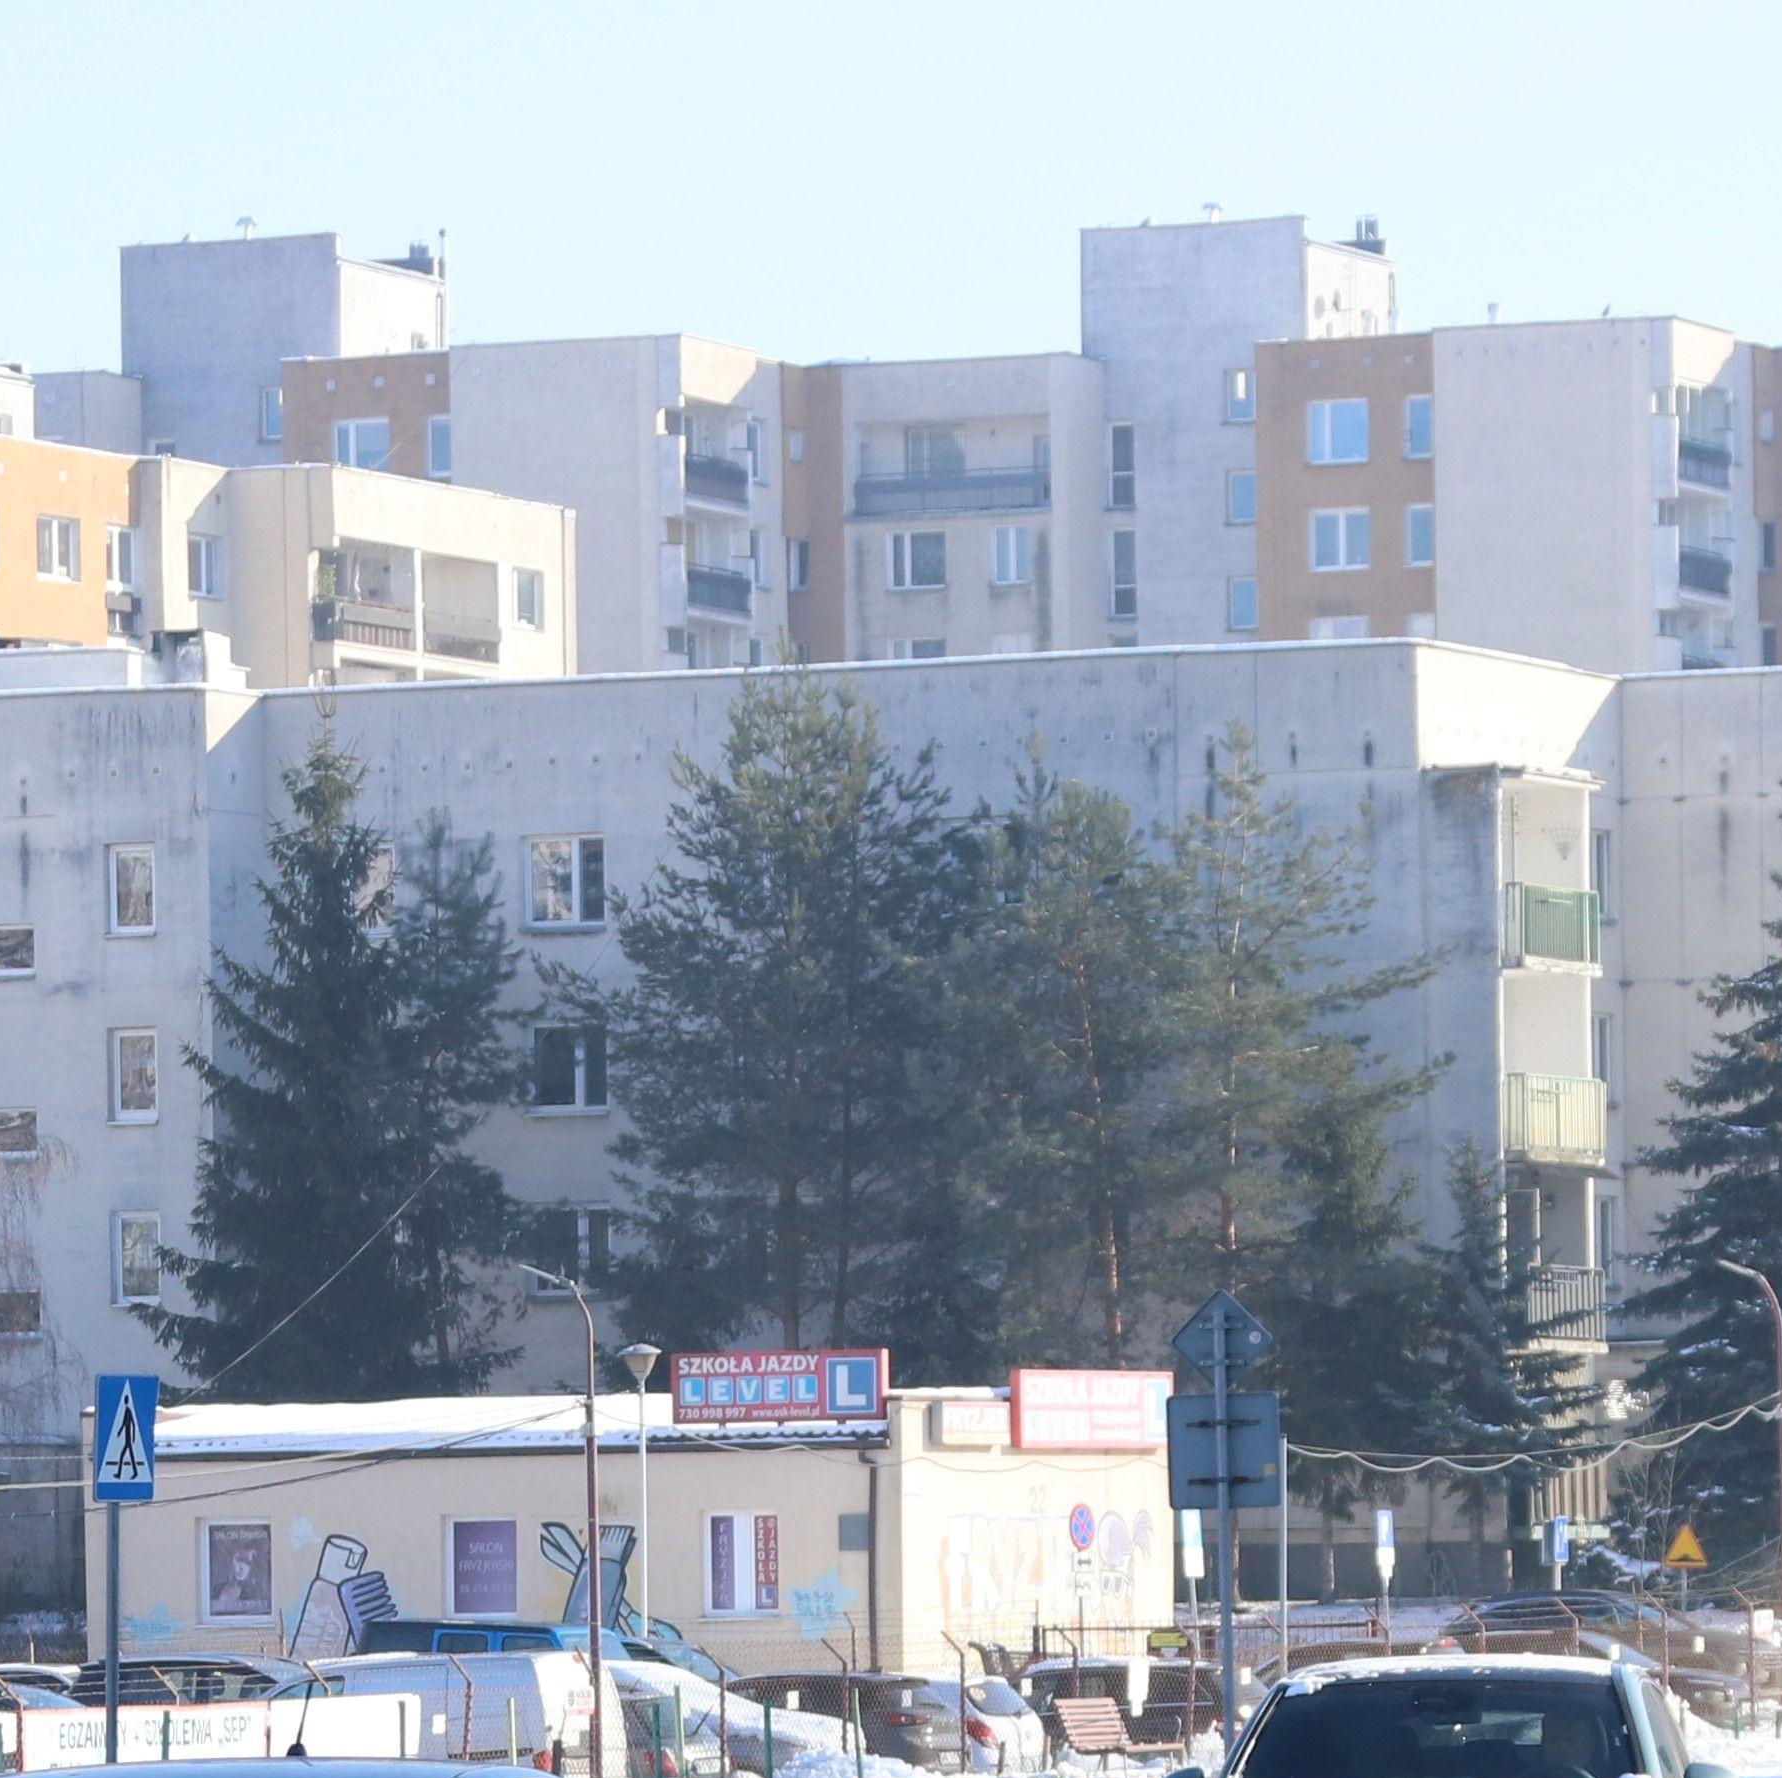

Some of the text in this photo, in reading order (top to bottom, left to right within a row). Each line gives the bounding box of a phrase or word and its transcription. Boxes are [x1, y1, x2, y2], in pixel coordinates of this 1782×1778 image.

[678, 1353, 819, 1375] SZKOŁA JAZDY
[683, 1377, 816, 1403] LEVEL
[678, 1407, 700, 1420] 730
[468, 1541, 504, 1554] SALON
